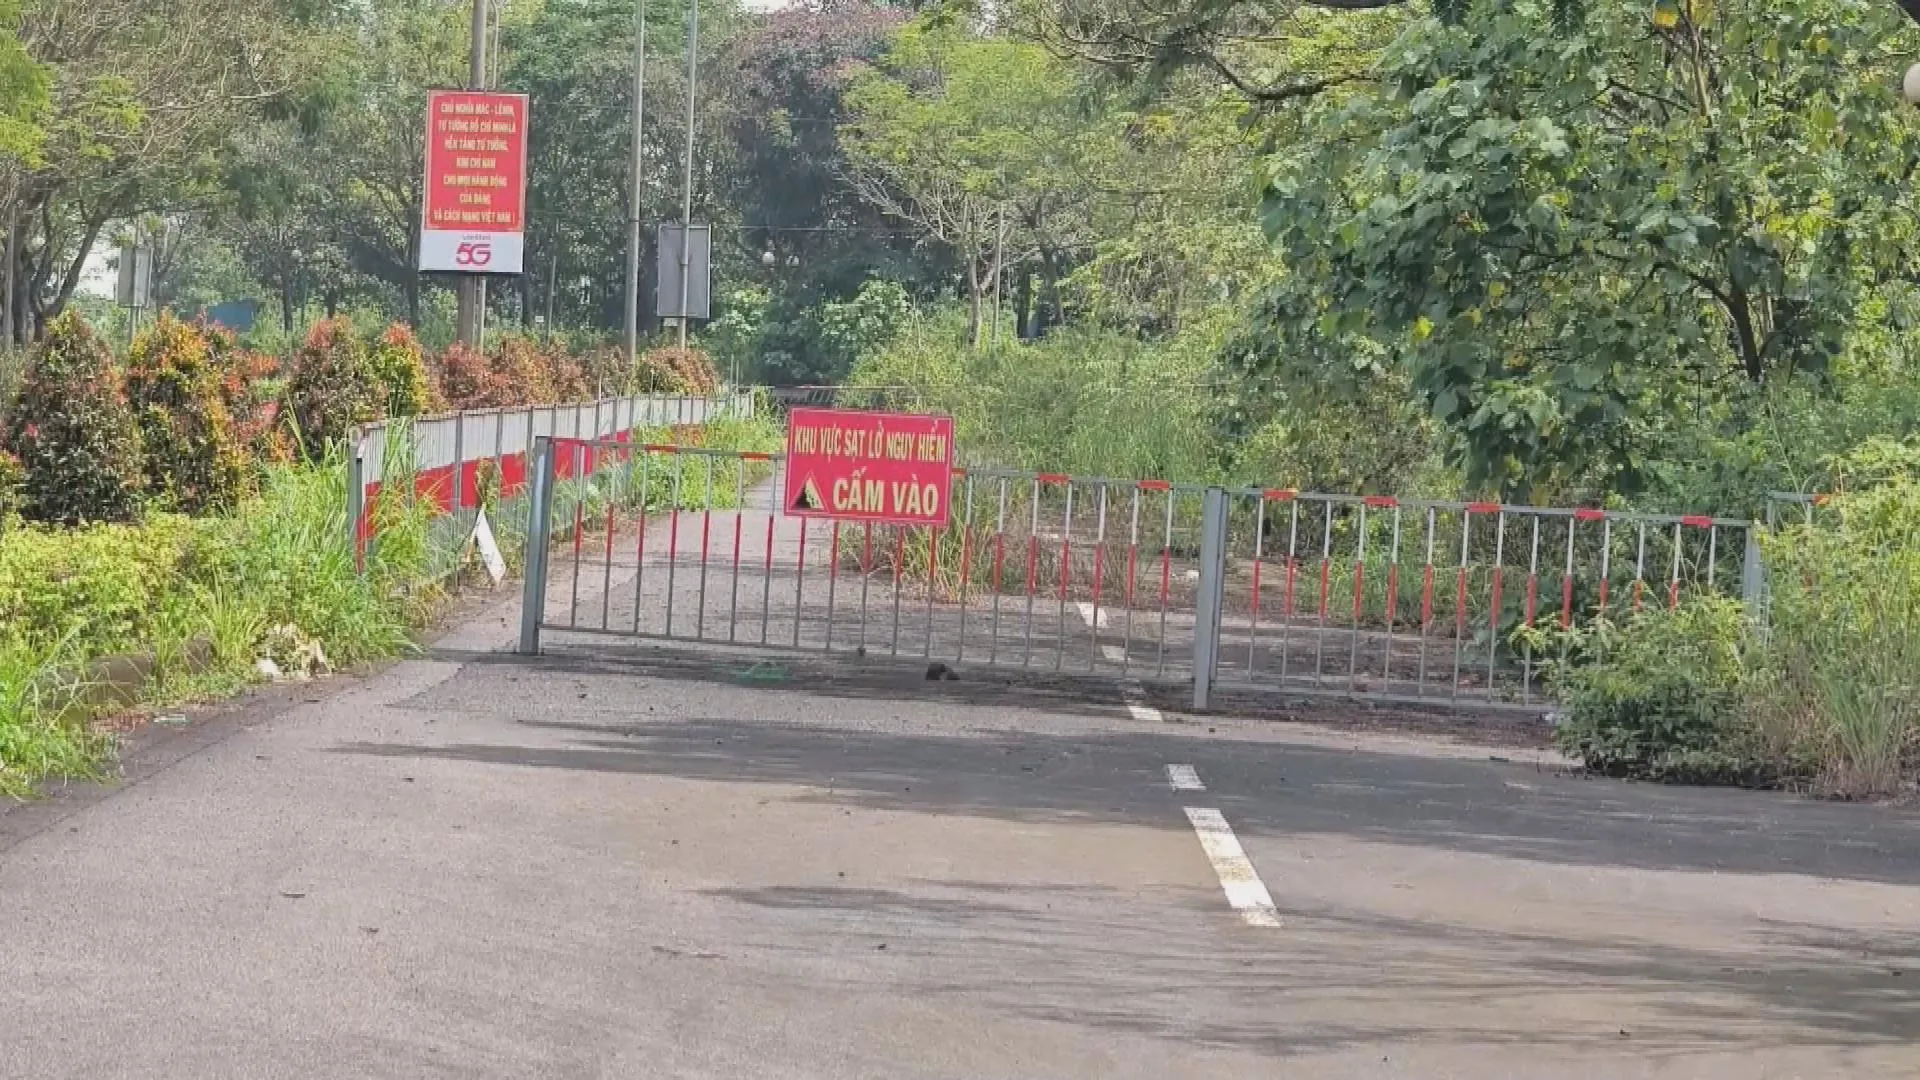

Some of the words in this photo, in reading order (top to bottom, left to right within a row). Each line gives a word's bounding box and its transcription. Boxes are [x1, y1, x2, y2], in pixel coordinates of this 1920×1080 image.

[456, 243, 491, 266] 5G
[794, 425, 817, 453] KHU
[820, 423, 841, 462] VỰC
[844, 429, 865, 463] SẠT
[868, 420, 884, 459] LỞ
[886, 432, 915, 461] NGUY
[917, 419, 947, 463] HIỂM
[833, 466, 885, 513] CẤM
[891, 474, 939, 516] VÀO
